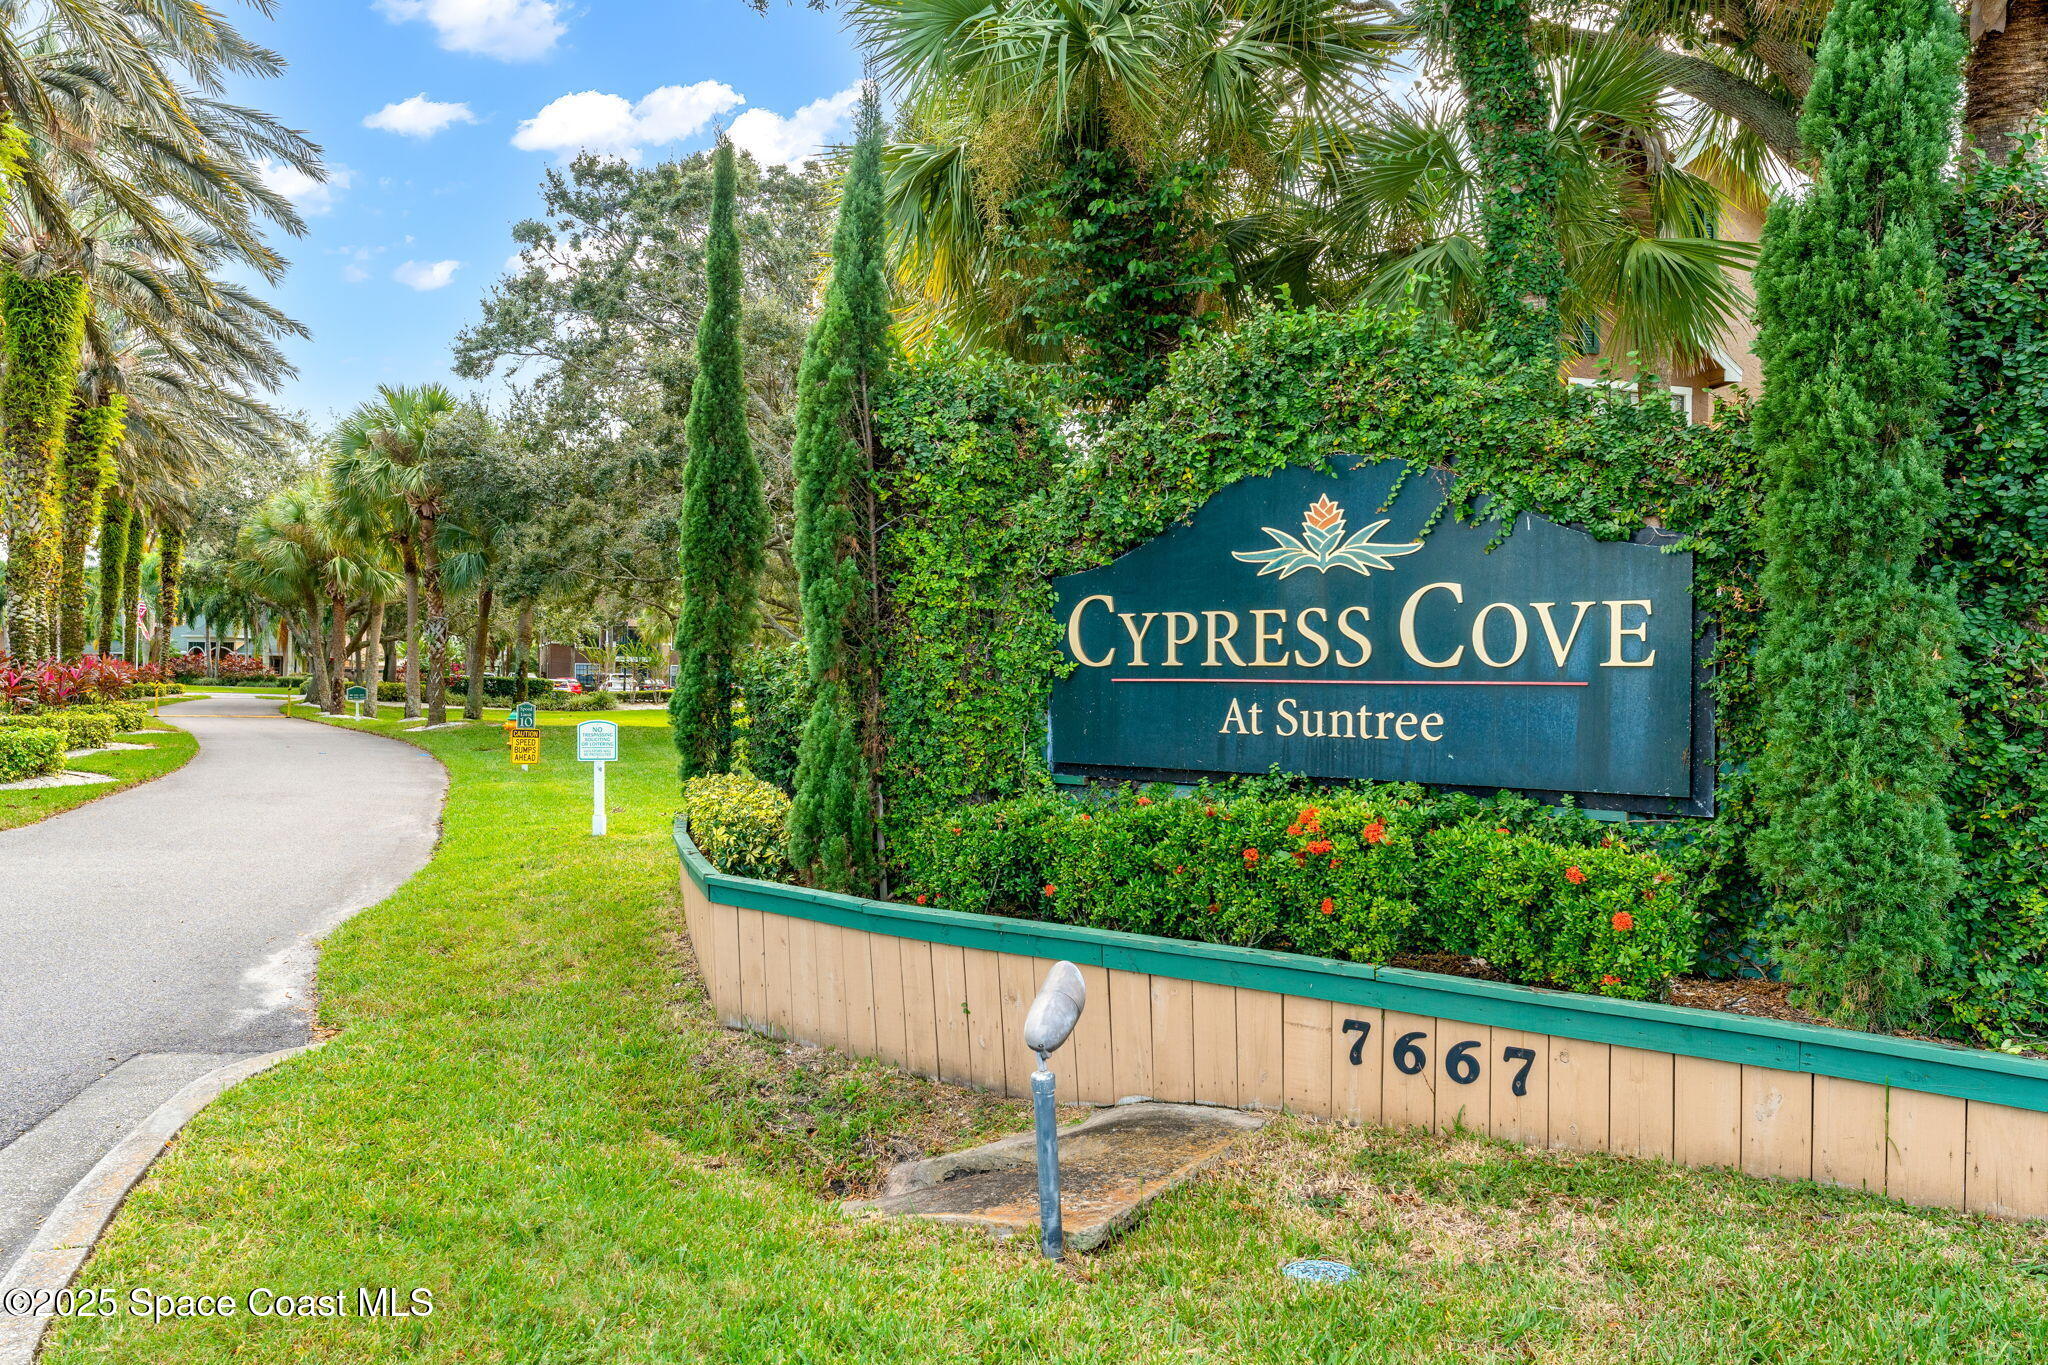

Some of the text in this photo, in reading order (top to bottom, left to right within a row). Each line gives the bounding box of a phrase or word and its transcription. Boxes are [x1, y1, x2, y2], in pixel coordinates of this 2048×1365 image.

[1067, 581, 1656, 669] CYPRESS COVE
[520, 717, 533, 727] 10
[1219, 697, 1445, 742] At Suntree
[514, 746, 537, 754] BUMPS
[515, 738, 536, 746] SPEED
[1342, 1019, 1536, 1097] 7667
